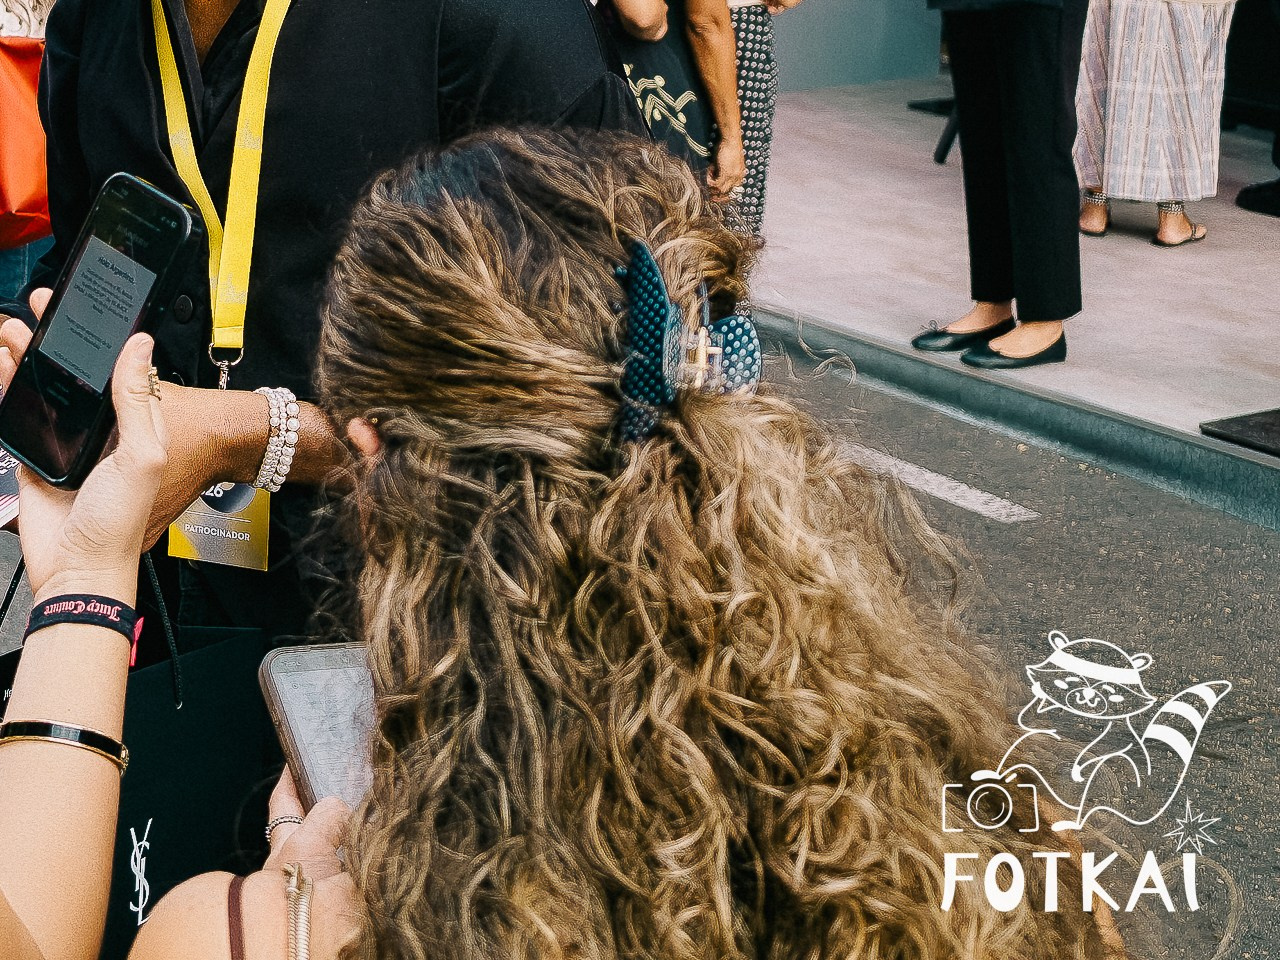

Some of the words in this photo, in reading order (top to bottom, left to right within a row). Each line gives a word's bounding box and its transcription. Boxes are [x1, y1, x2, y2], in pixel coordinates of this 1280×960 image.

[184, 523, 251, 542] PATROCINADOR
[43, 600, 86, 616] Couture
[87, 599, 122, 622] Juicy
